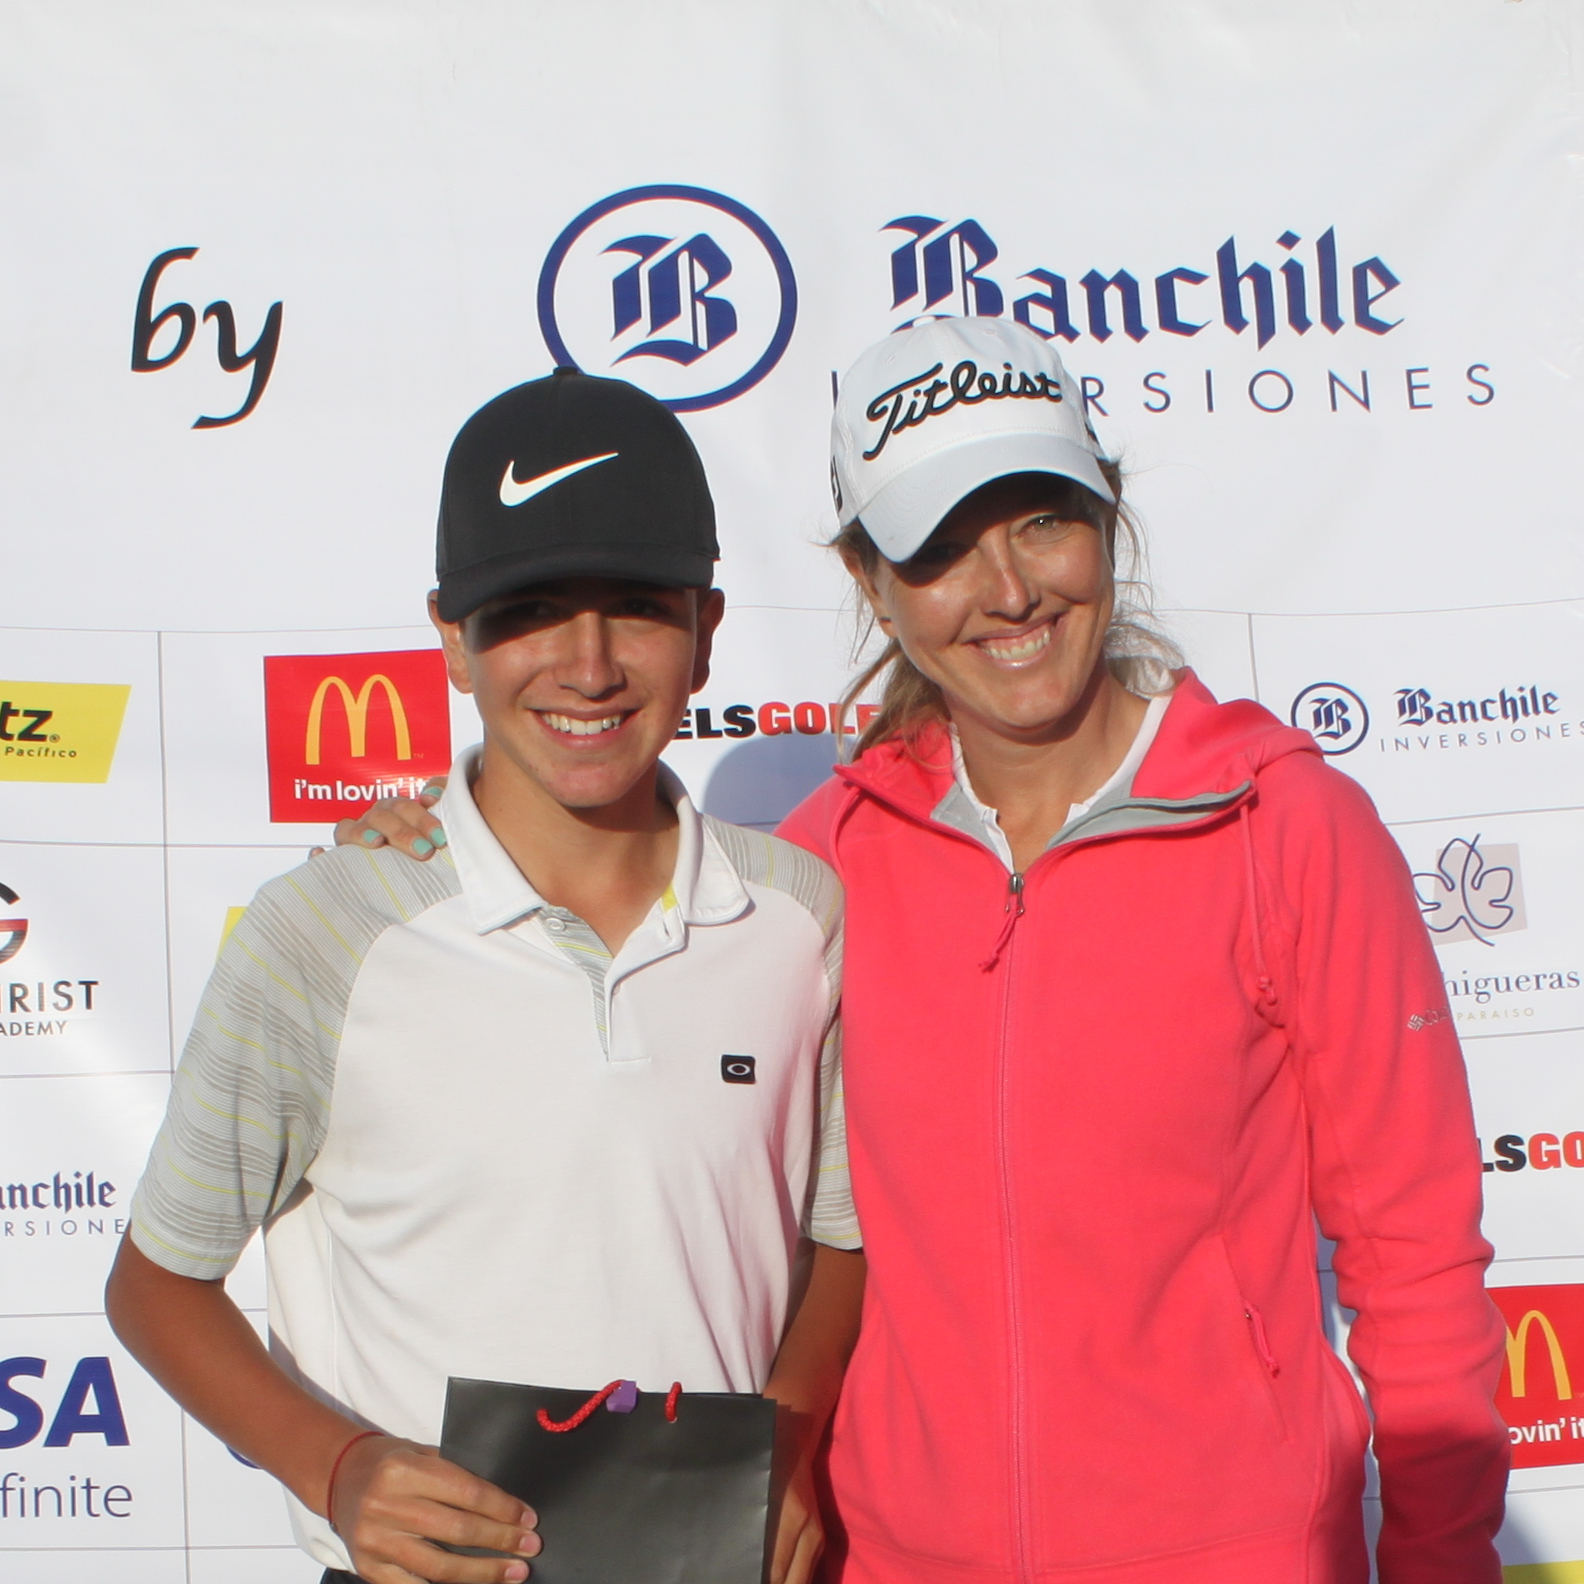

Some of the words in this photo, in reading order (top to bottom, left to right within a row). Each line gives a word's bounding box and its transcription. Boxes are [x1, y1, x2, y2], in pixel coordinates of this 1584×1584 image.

[878, 214, 1406, 352] Banchile
[130, 246, 285, 430] by
[861, 359, 1063, 461] Titleist
[1392, 684, 1562, 729] Banchile
[4, 744, 78, 760] Pacífico
[1456, 1006, 1535, 1022] PARAISO
